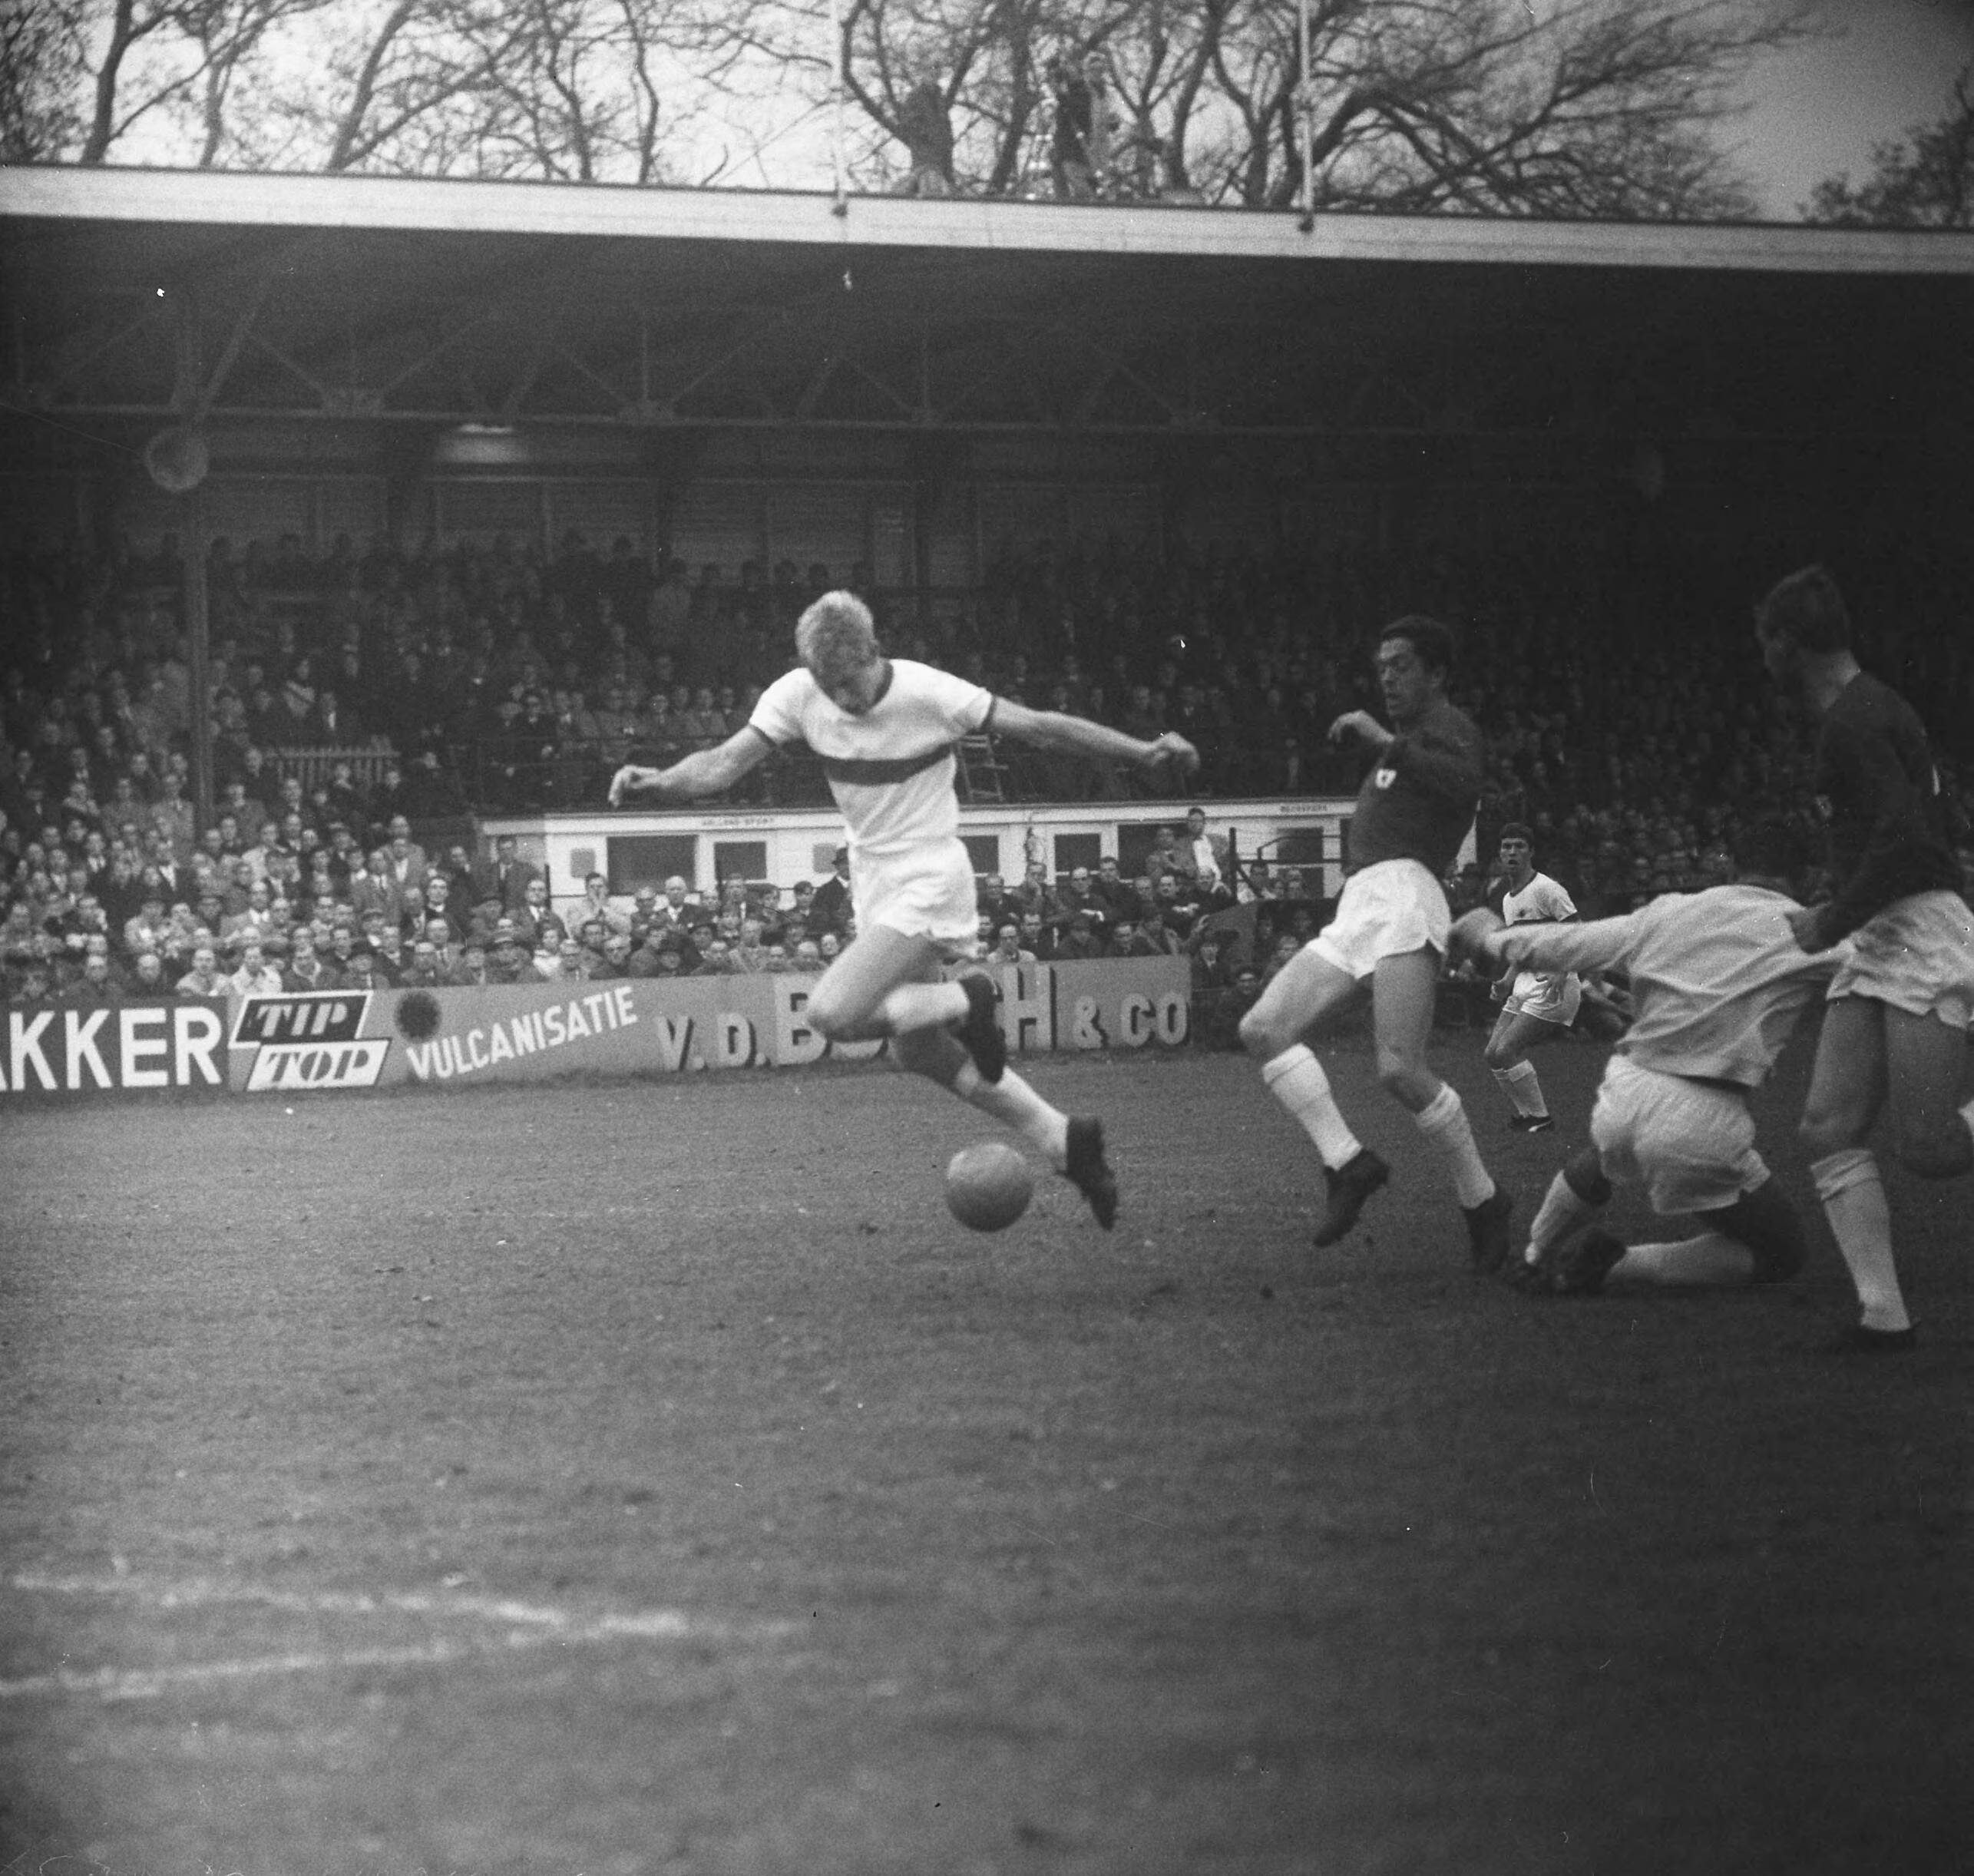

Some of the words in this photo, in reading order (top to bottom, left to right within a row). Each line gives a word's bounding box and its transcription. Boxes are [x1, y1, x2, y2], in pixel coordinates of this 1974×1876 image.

[256, 1002, 348, 1037] TIP
[406, 986, 638, 1080] VULCANISATIE
[1076, 996, 1106, 1050] &
[1121, 992, 1189, 1048] CO
[267, 1049, 369, 1083] TOP
